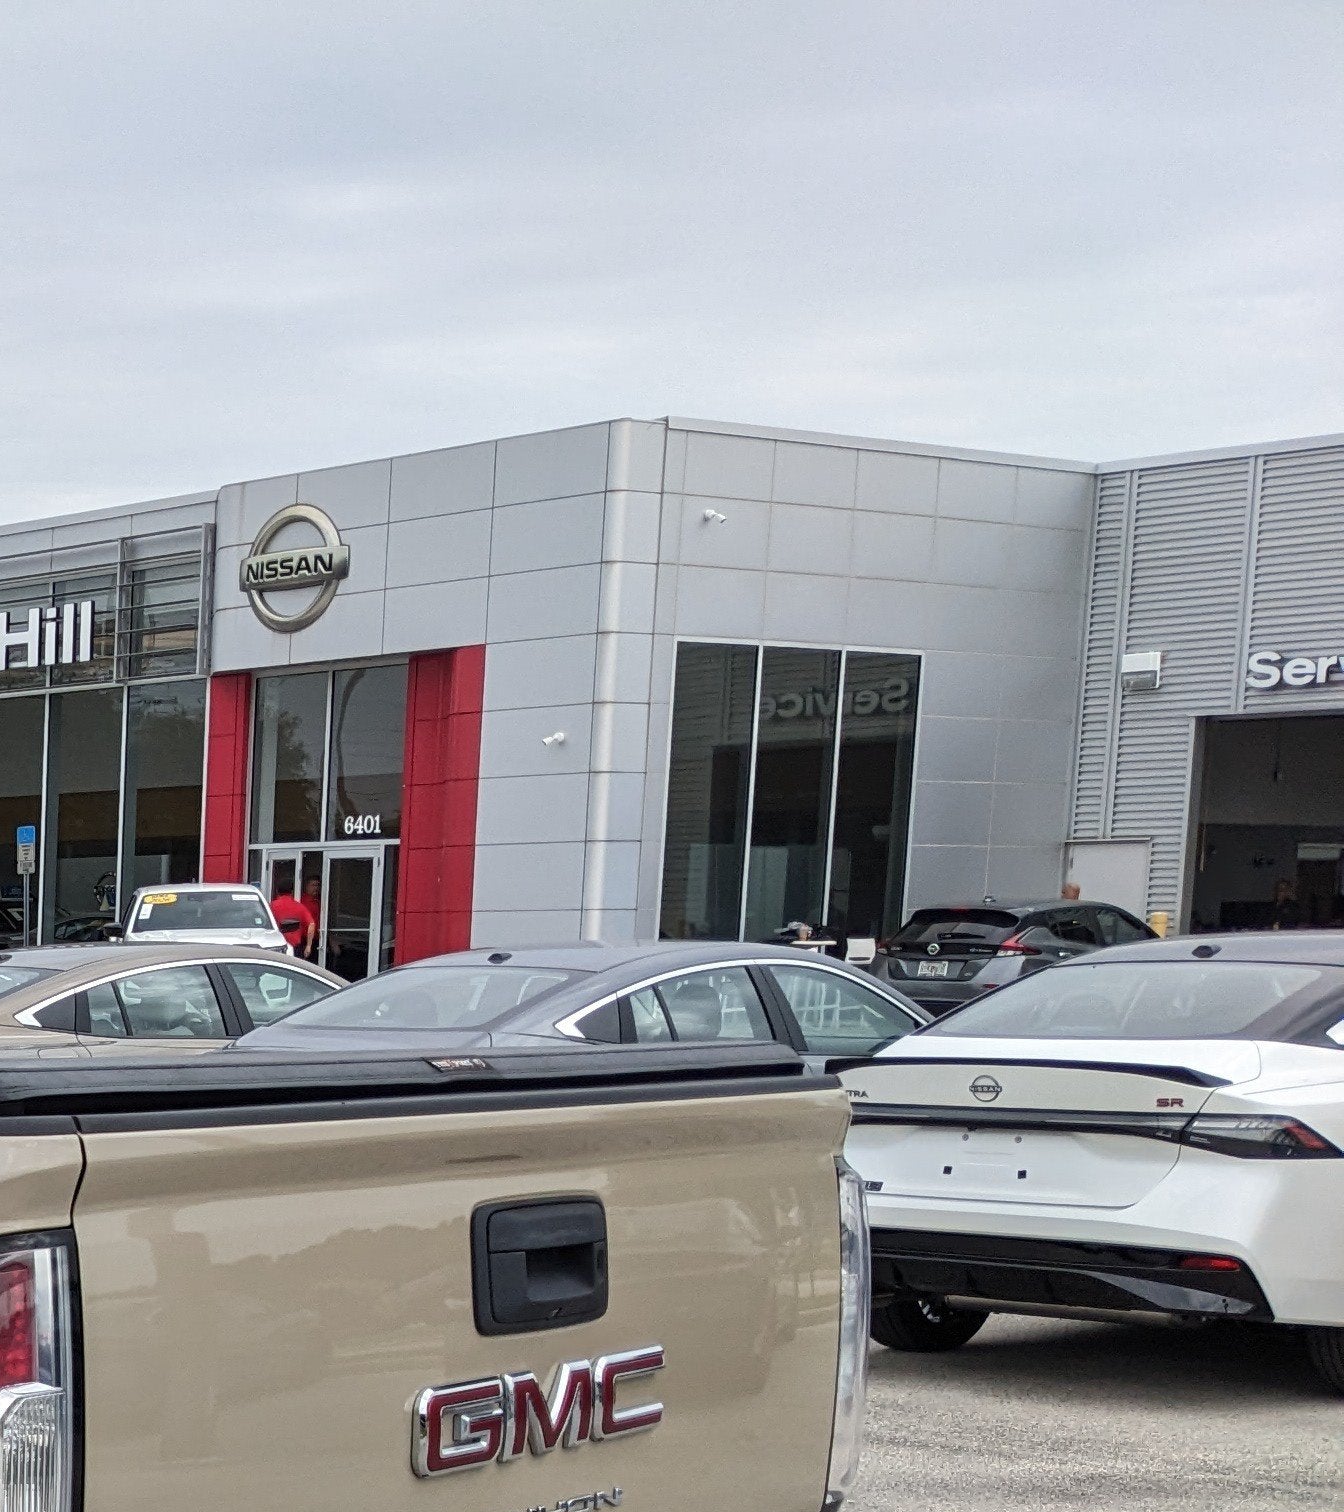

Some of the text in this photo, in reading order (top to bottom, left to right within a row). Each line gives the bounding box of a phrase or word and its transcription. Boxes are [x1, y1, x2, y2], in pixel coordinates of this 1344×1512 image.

[245, 553, 333, 582] NISSAN
[344, 814, 382, 835] 6401
[1155, 1098, 1185, 1108] SR
[410, 1345, 665, 1478] GMC
